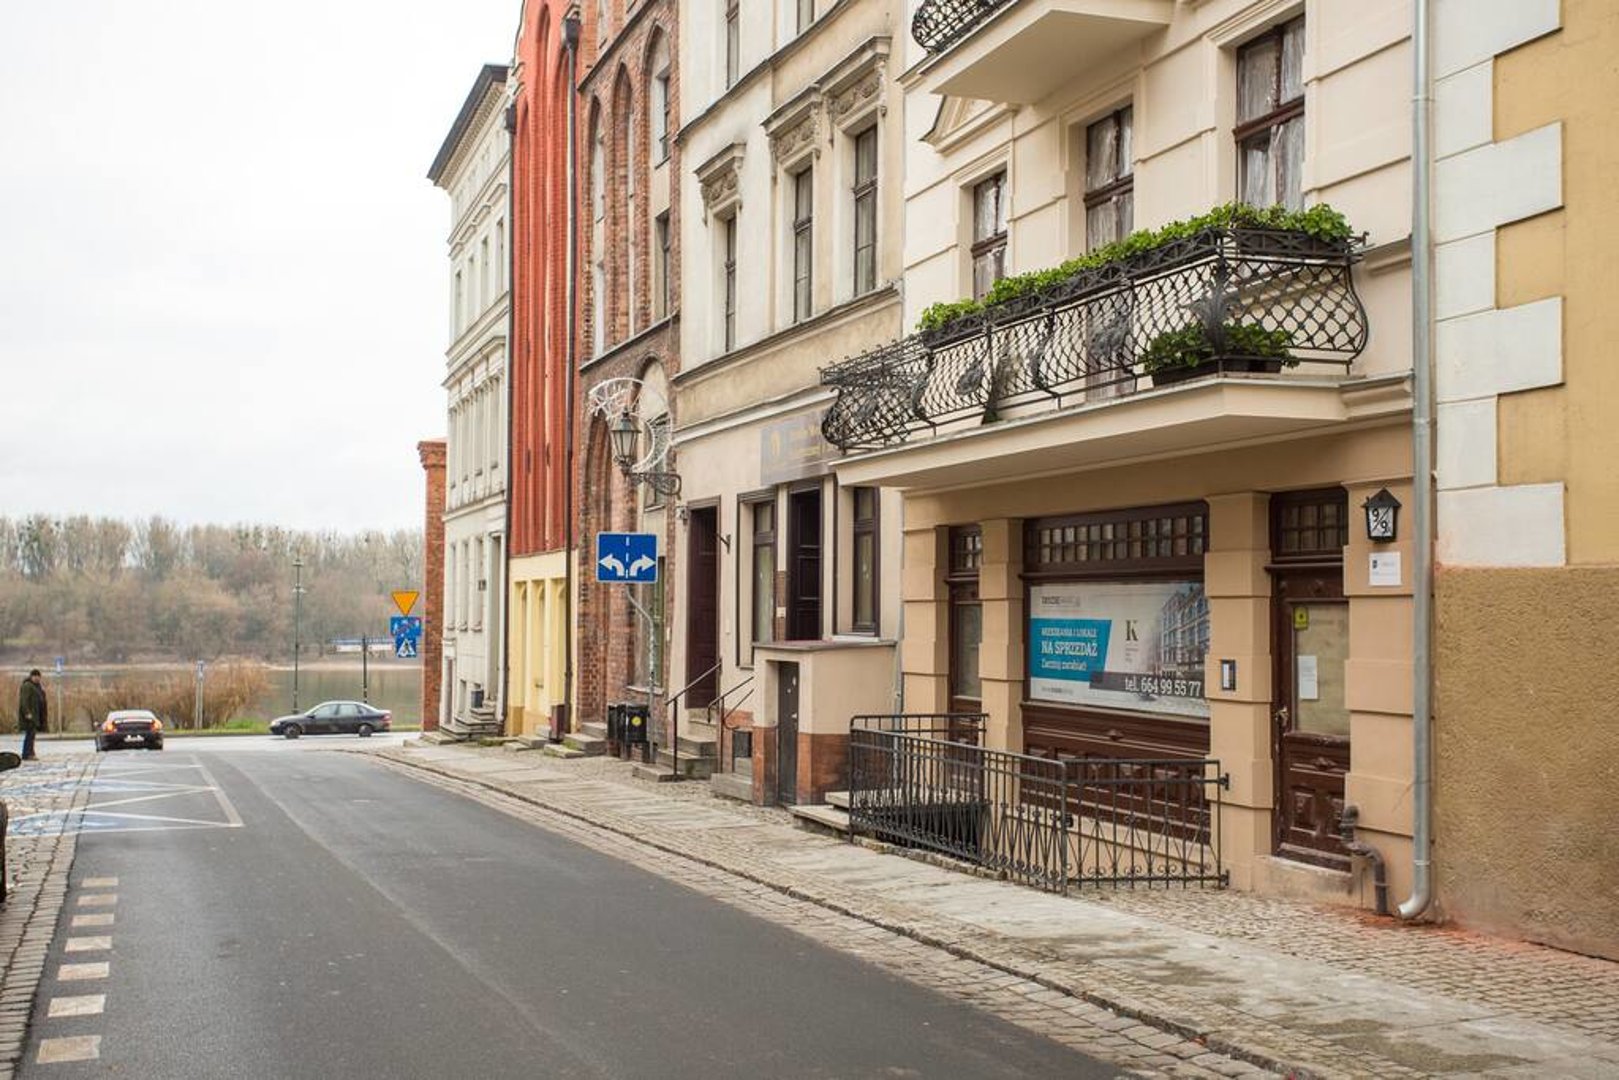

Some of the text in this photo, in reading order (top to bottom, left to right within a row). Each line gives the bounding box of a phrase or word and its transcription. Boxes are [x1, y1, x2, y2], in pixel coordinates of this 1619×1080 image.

[1125, 620, 1138, 641] K
[1041, 640, 1098, 657] NA SPRZEDAŻ
[1125, 676, 1201, 697] tel. 664 99 55 77
